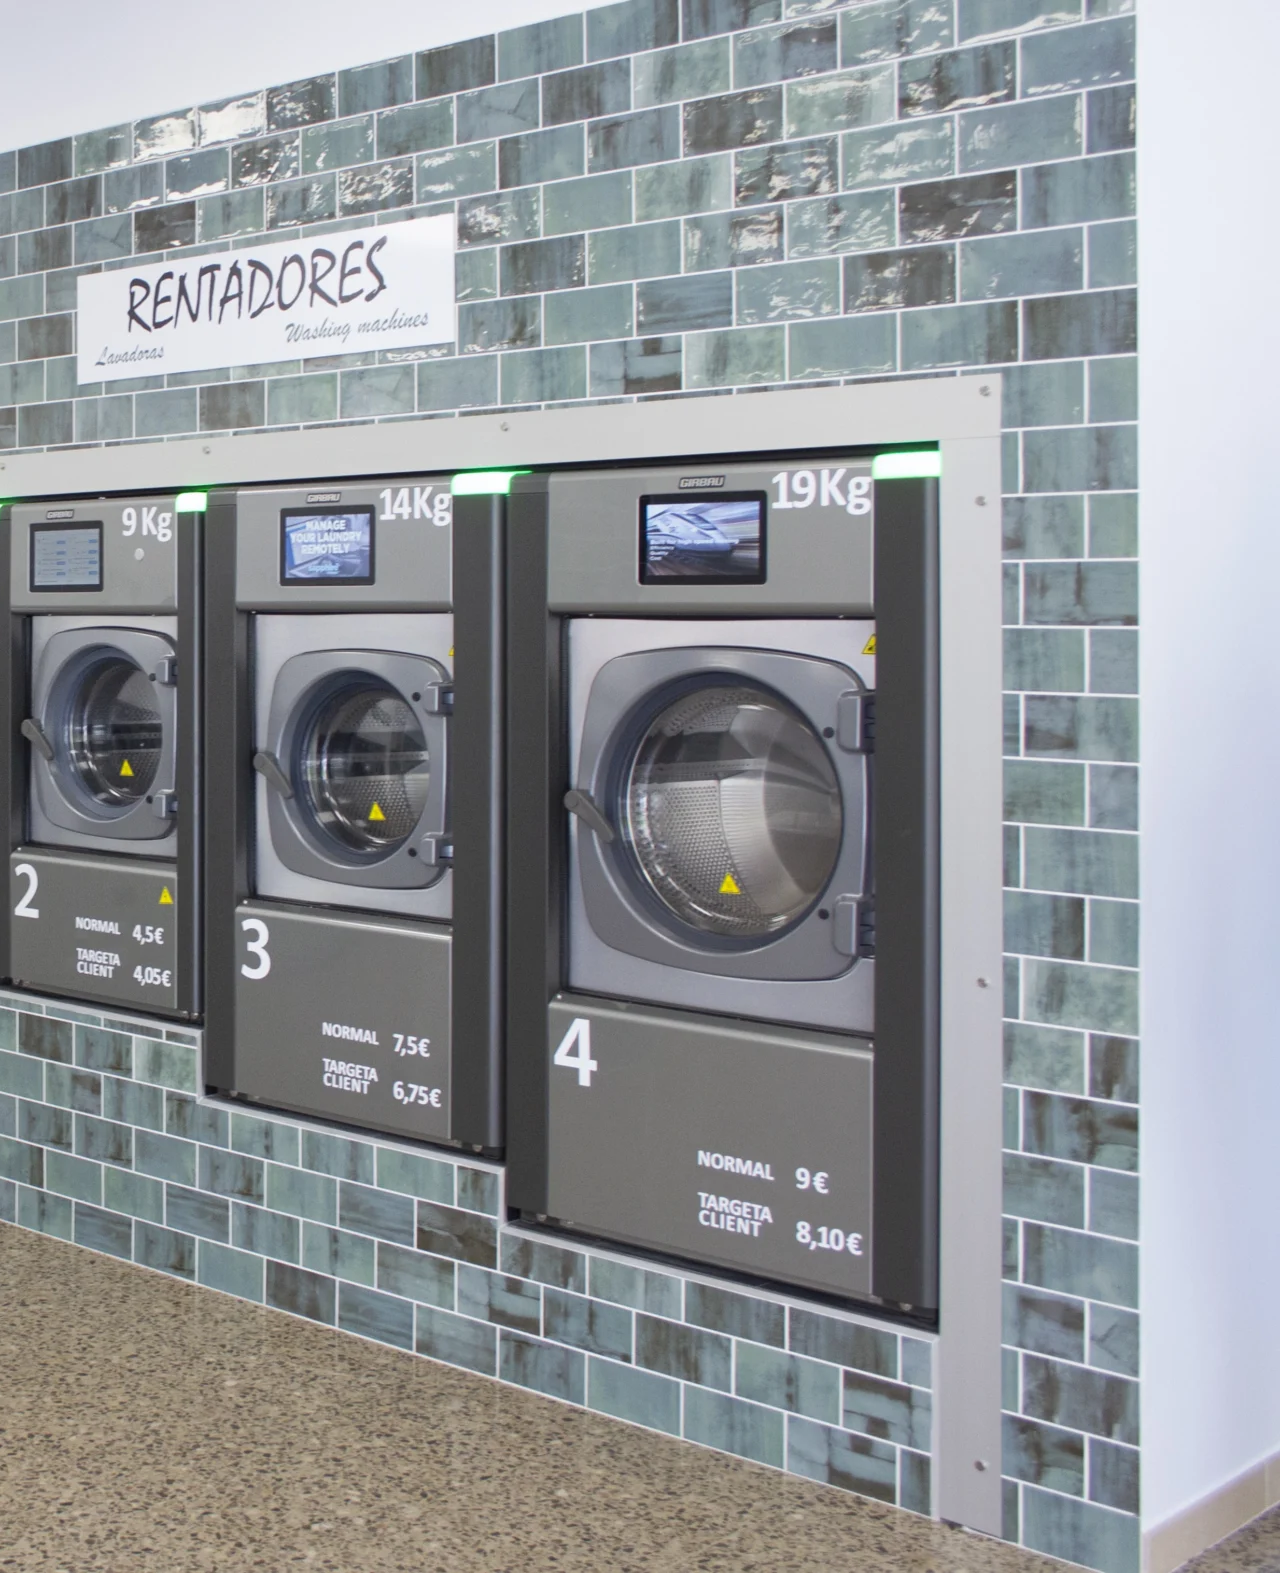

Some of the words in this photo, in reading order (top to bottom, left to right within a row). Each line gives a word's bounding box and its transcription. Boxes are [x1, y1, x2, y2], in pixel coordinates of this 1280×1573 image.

[127, 235, 388, 333] RENTADORES
[285, 317, 351, 344] Washing
[357, 308, 429, 335] machines
[94, 344, 165, 367] Lavadoras
[306, 493, 341, 503] GIRBAU
[679, 476, 724, 488] GIRBAU
[771, 468, 872, 515] 19Kg
[379, 486, 452, 526] 14Kg
[290, 532, 316, 543] YOUR
[317, 531, 362, 543] LAUNDRY
[306, 519, 347, 530] MANAGE
[301, 543, 350, 554] REMOTELY
[14, 863, 39, 918] 2
[75, 916, 121, 935] NORMAL
[132, 924, 164, 945] 4,5€
[76, 948, 121, 966] TARGETA
[241, 918, 271, 980] 3
[76, 961, 114, 978] CLIENT
[133, 965, 172, 987] 4,05€
[322, 1022, 379, 1045] NORMAL
[392, 1033, 430, 1057] 7,5€
[554, 1017, 598, 1087] 4
[322, 1058, 378, 1082] TARGETA
[323, 1073, 370, 1094] CLIENT
[392, 1081, 441, 1108] 6,75€
[697, 1150, 774, 1181] NORMAL
[795, 1168, 829, 1194] 9€
[698, 1192, 773, 1223] TARGETA
[698, 1210, 762, 1237] CLIENT
[795, 1221, 863, 1256] 8,10€
